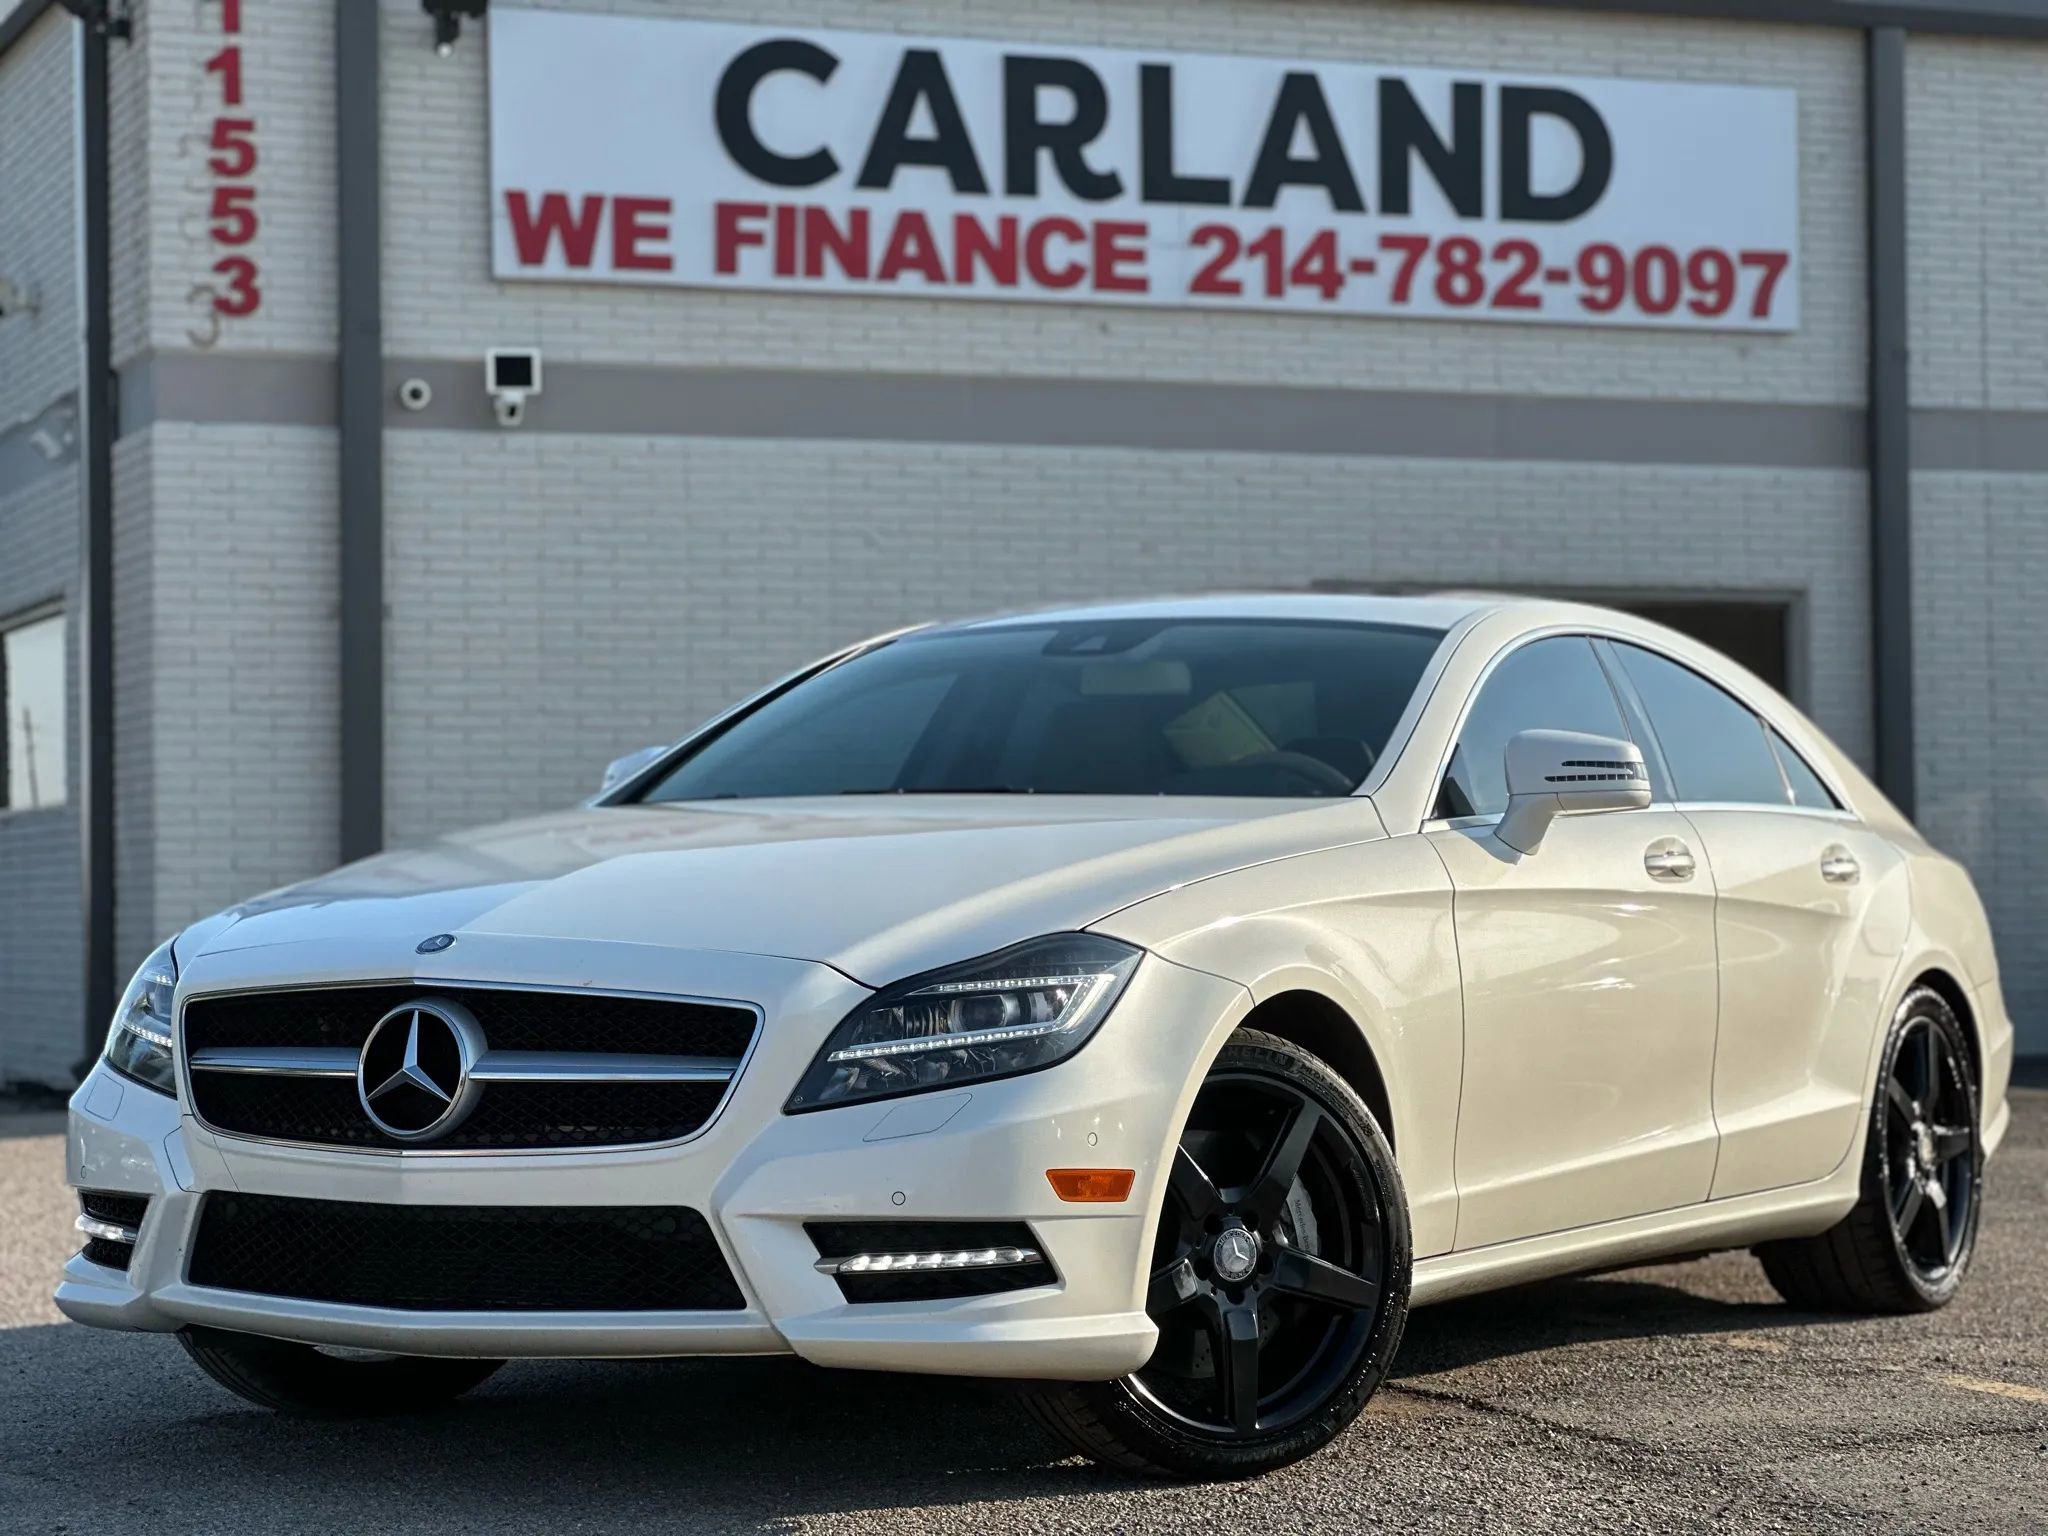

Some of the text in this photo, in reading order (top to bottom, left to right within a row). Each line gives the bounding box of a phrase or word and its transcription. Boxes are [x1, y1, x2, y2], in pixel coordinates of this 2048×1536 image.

[714, 37, 1614, 225] CARLAND
[505, 190, 1790, 319] WE FINANCE 214-782-9097
